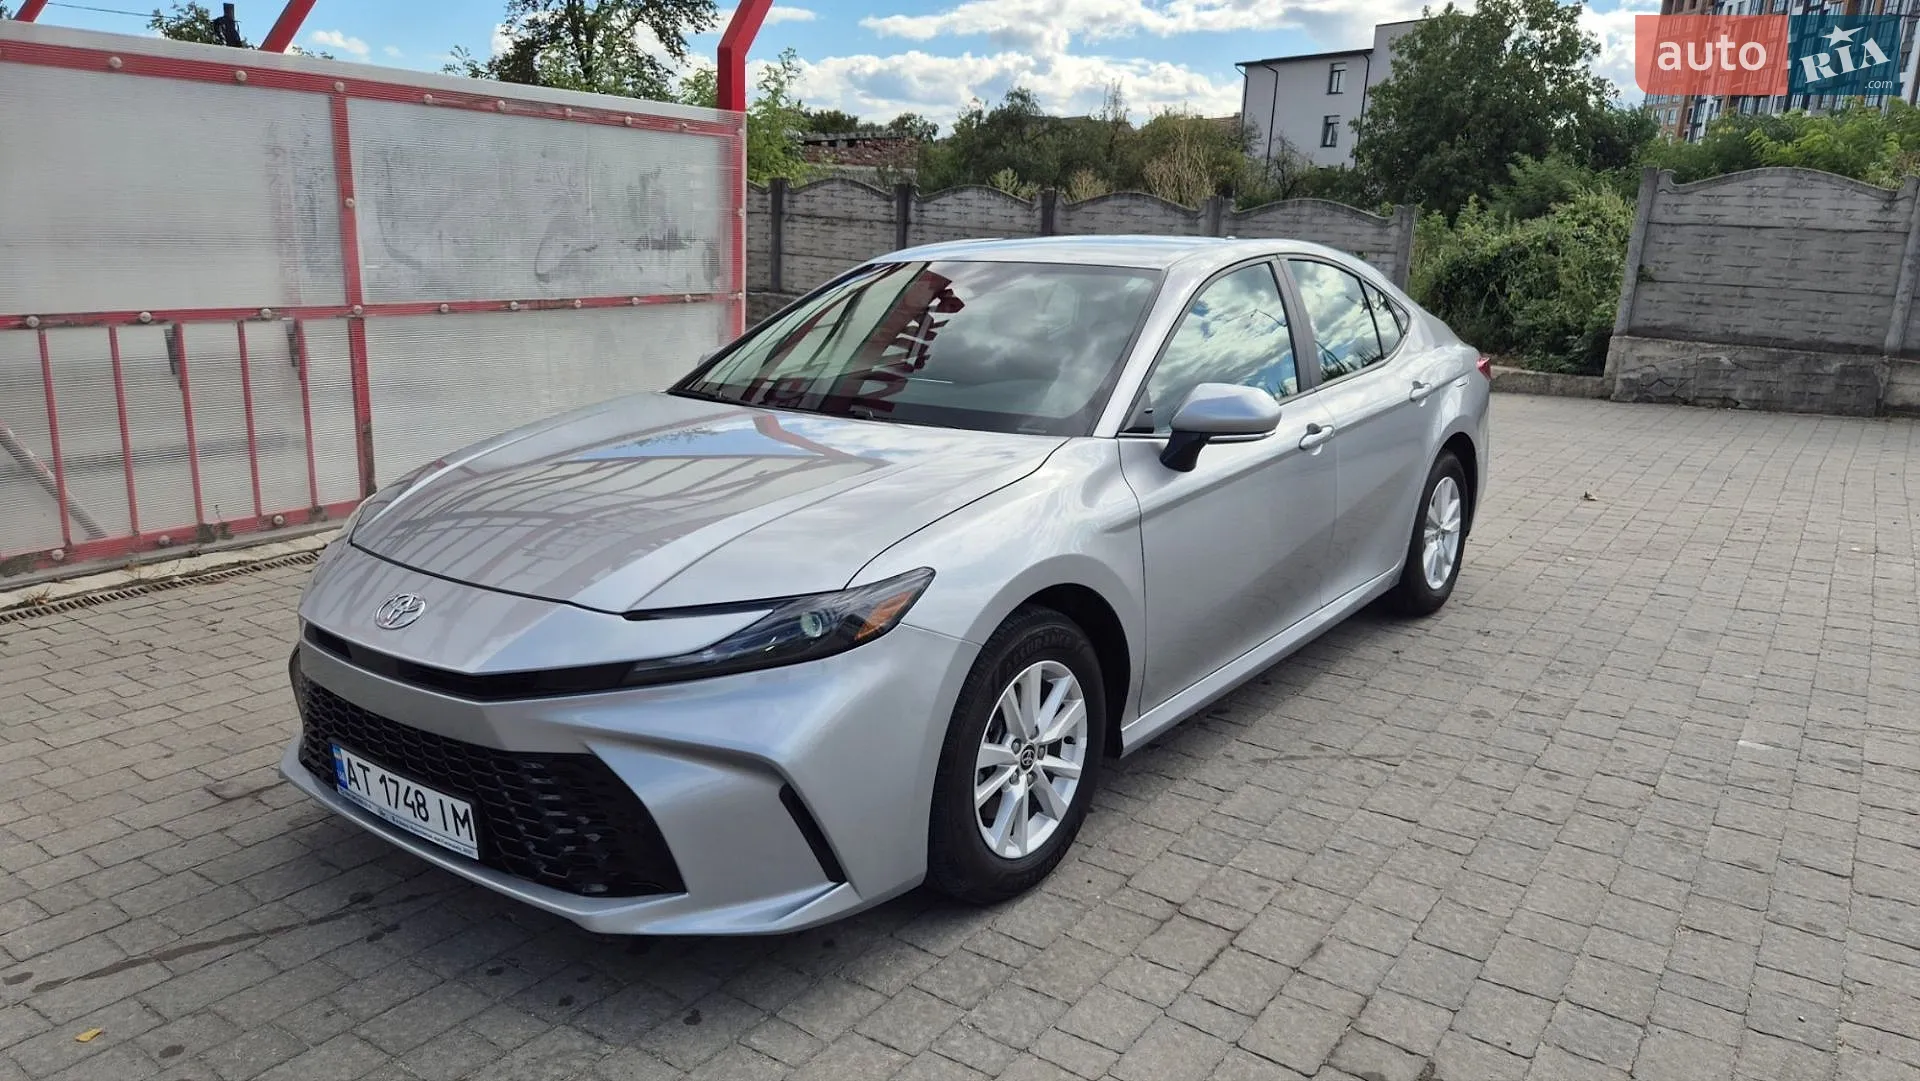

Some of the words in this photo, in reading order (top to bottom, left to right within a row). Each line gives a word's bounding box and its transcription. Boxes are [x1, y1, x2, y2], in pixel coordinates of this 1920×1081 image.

[347, 757, 370, 796] AT
[379, 774, 430, 822] 1748
[439, 798, 474, 842] IM
